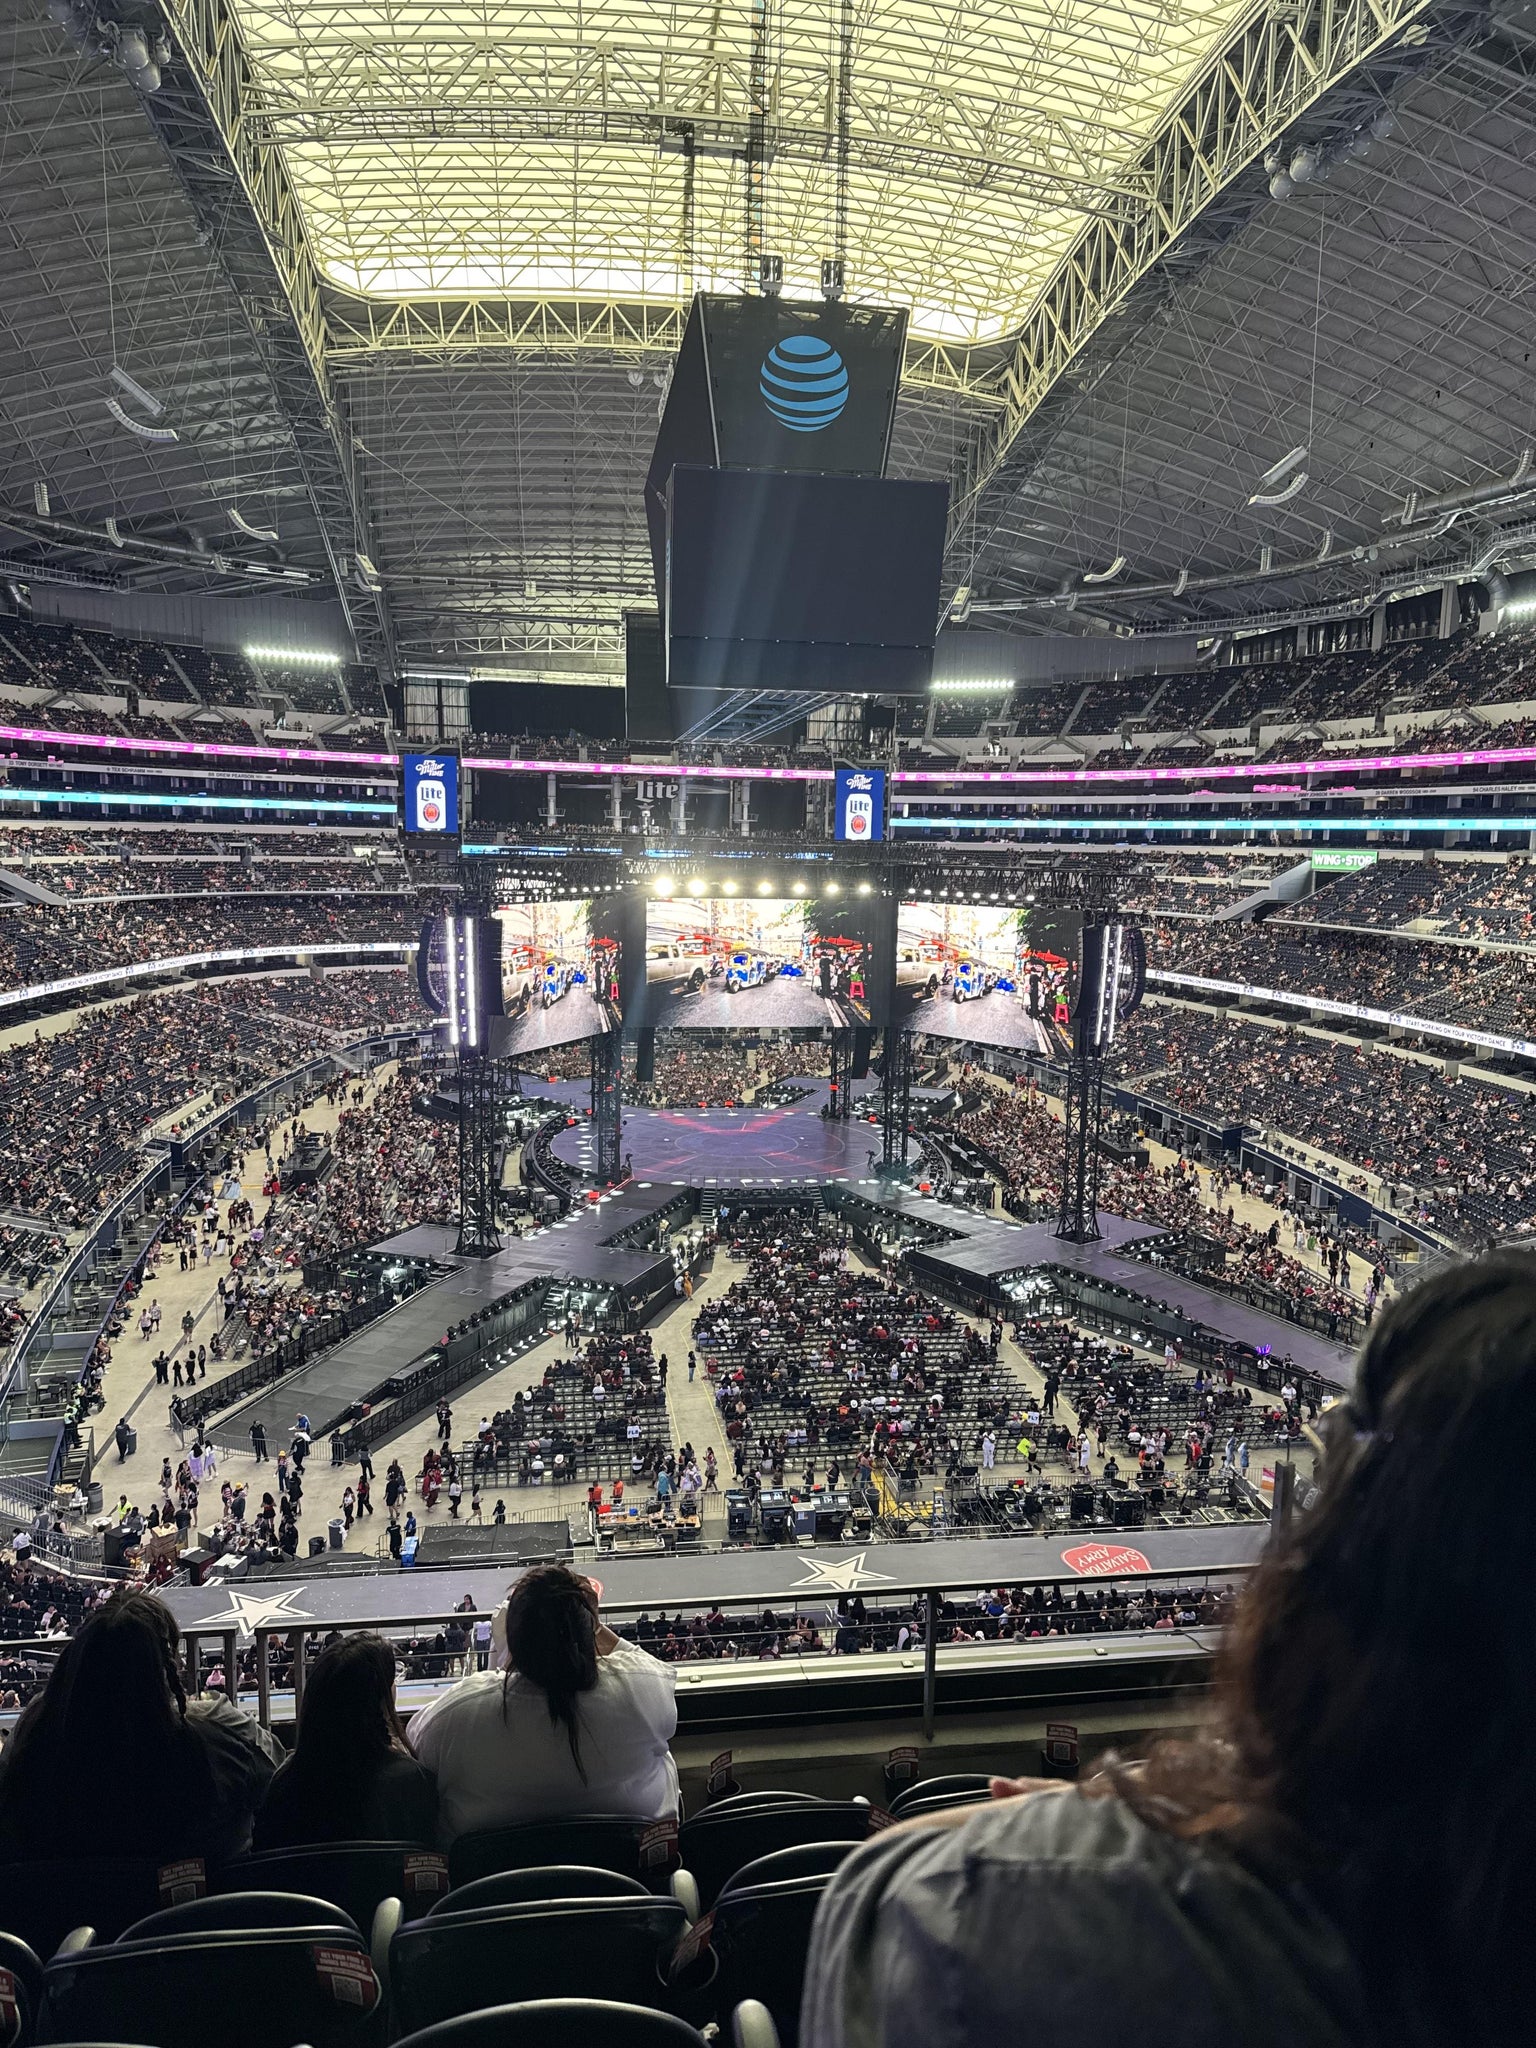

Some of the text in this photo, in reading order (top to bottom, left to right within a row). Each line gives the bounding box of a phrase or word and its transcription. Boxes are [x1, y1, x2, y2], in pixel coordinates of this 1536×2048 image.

[421, 787, 442, 801] Lite
[635, 781, 679, 802] Lite
[850, 800, 869, 813] Lite
[1421, 1023, 1442, 1033] WORKING
[1466, 1033, 1488, 1043] VICTORY
[1488, 1037, 1506, 1047] DANCE
[1077, 1547, 1110, 1567] ARMY
[1083, 1551, 1140, 1575] SALVATION
